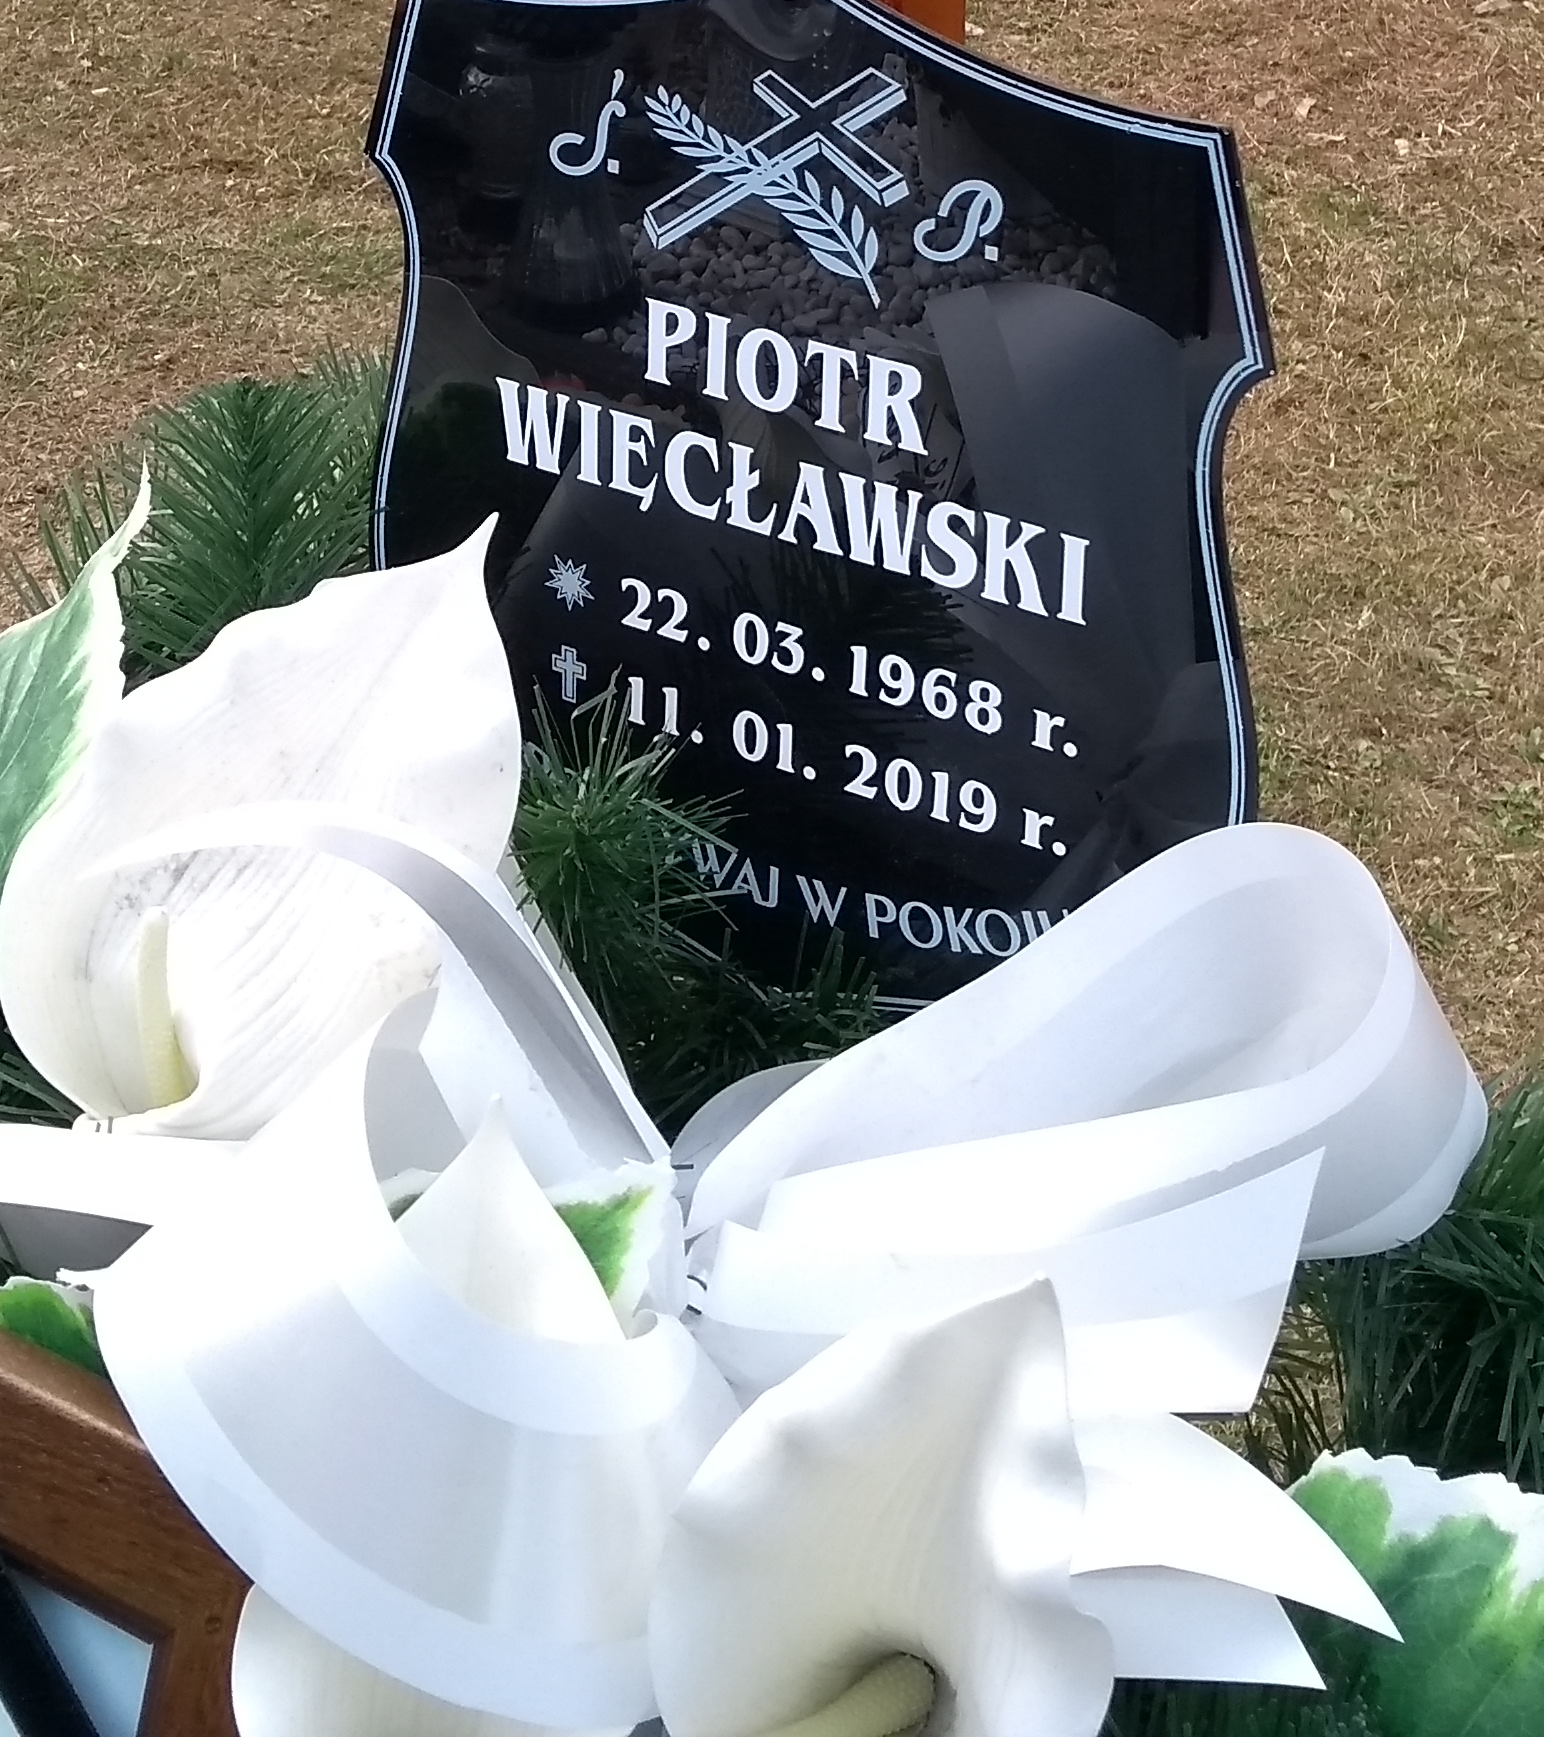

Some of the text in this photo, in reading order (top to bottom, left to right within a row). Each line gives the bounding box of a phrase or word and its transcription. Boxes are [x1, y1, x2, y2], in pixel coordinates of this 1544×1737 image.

[643, 296, 929, 456] PIOTR
[495, 376, 1091, 626] WIĘCŁAWSKI
[620, 577, 1079, 758] 22. 03. 1968 r.
[627, 676, 1068, 857] 11. 01. 2019 r.
[796, 874, 848, 928] W
